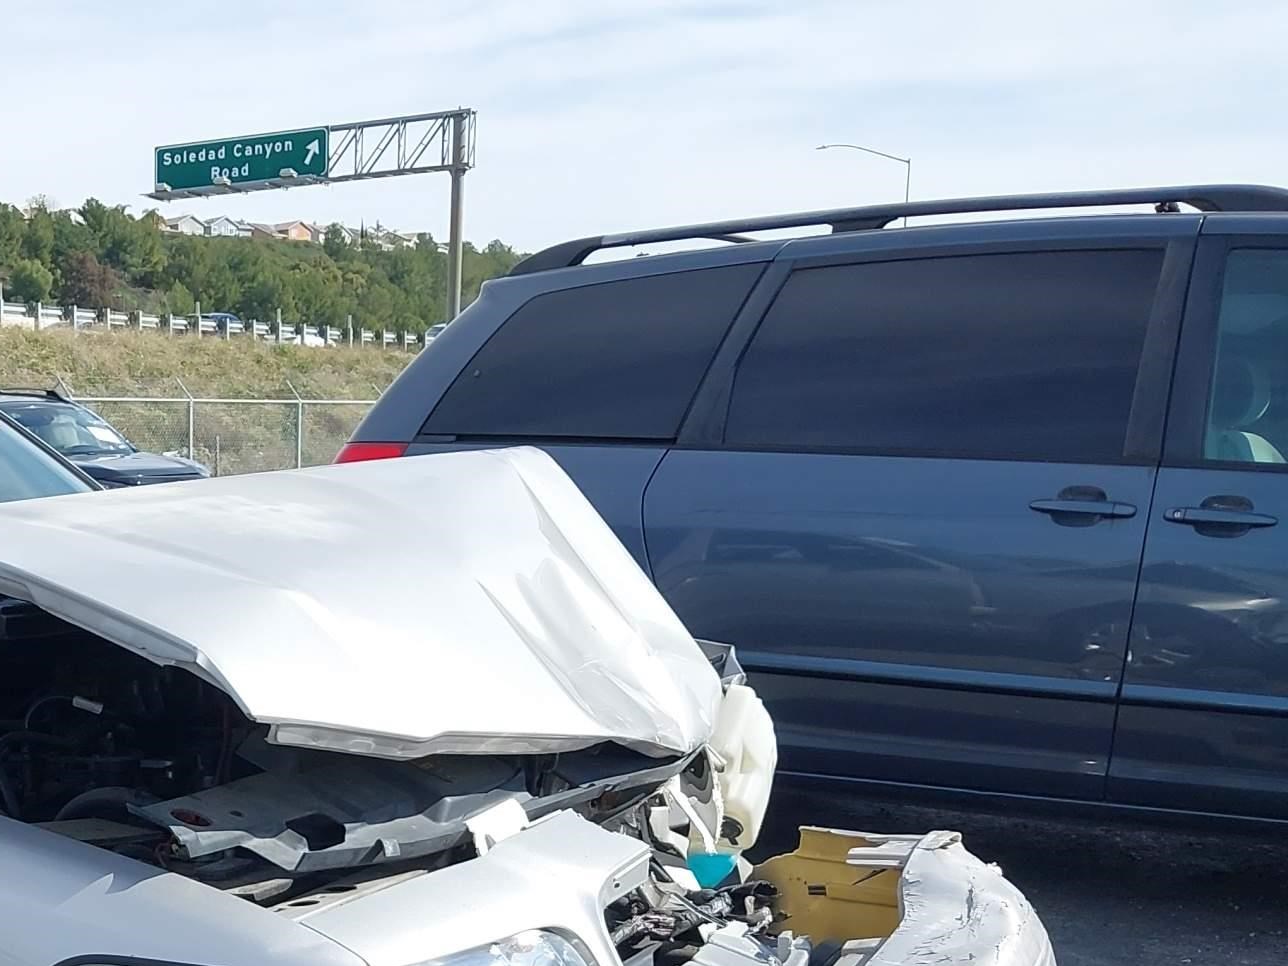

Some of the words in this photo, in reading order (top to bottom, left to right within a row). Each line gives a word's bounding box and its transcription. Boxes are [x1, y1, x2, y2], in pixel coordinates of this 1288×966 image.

[162, 146, 226, 166] Soledad
[233, 140, 293, 159] Canyon
[210, 163, 250, 180] Road
